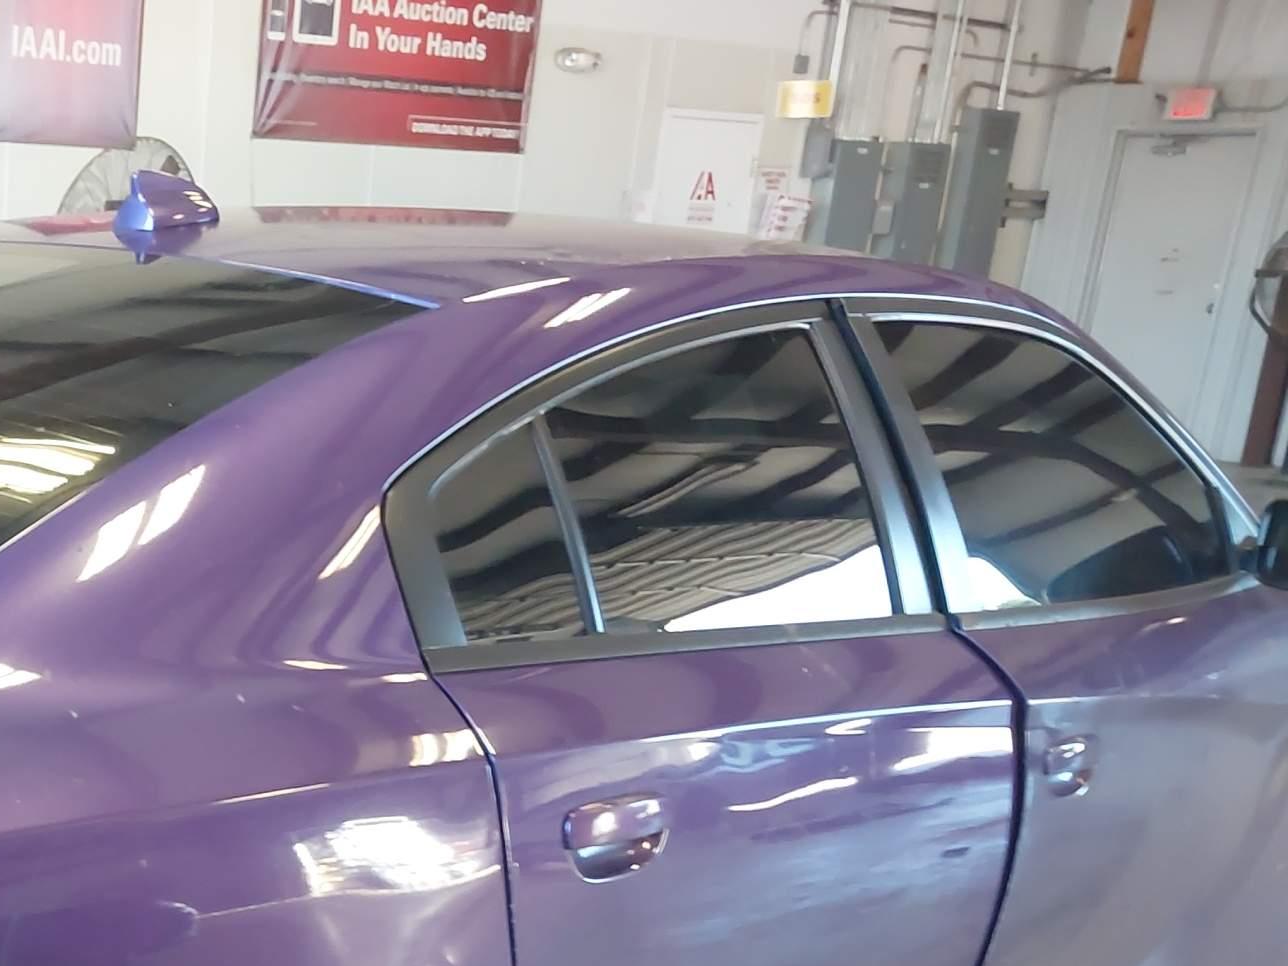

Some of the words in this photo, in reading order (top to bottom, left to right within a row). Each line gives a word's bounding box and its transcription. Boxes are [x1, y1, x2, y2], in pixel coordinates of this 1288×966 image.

[351, 0, 389, 17] IAA
[393, 0, 468, 26] Auction
[472, 3, 534, 33] Center
[11, 24, 121, 66] IAAI.com
[349, 23, 369, 49] In
[375, 26, 421, 54] Your
[426, 32, 487, 61] Hands
